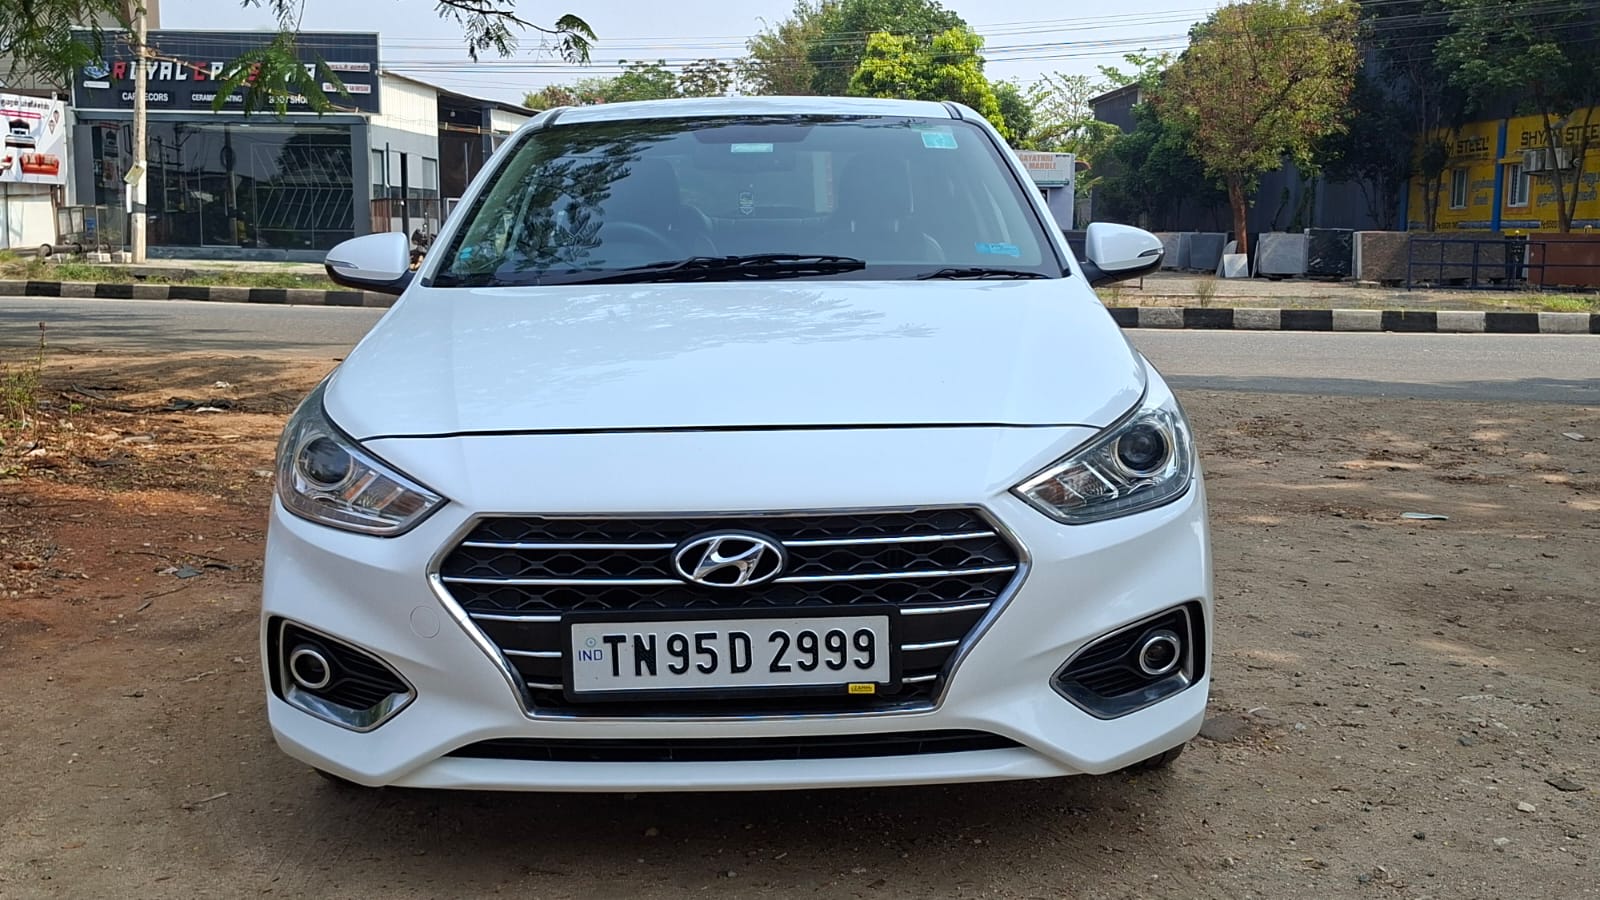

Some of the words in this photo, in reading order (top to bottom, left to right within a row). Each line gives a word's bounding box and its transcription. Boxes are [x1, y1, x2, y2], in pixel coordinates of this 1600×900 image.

[145, 93, 169, 102] ECORS
[578, 649, 603, 662] IND
[602, 631, 753, 677] TN95D
[768, 628, 876, 673] 2999
